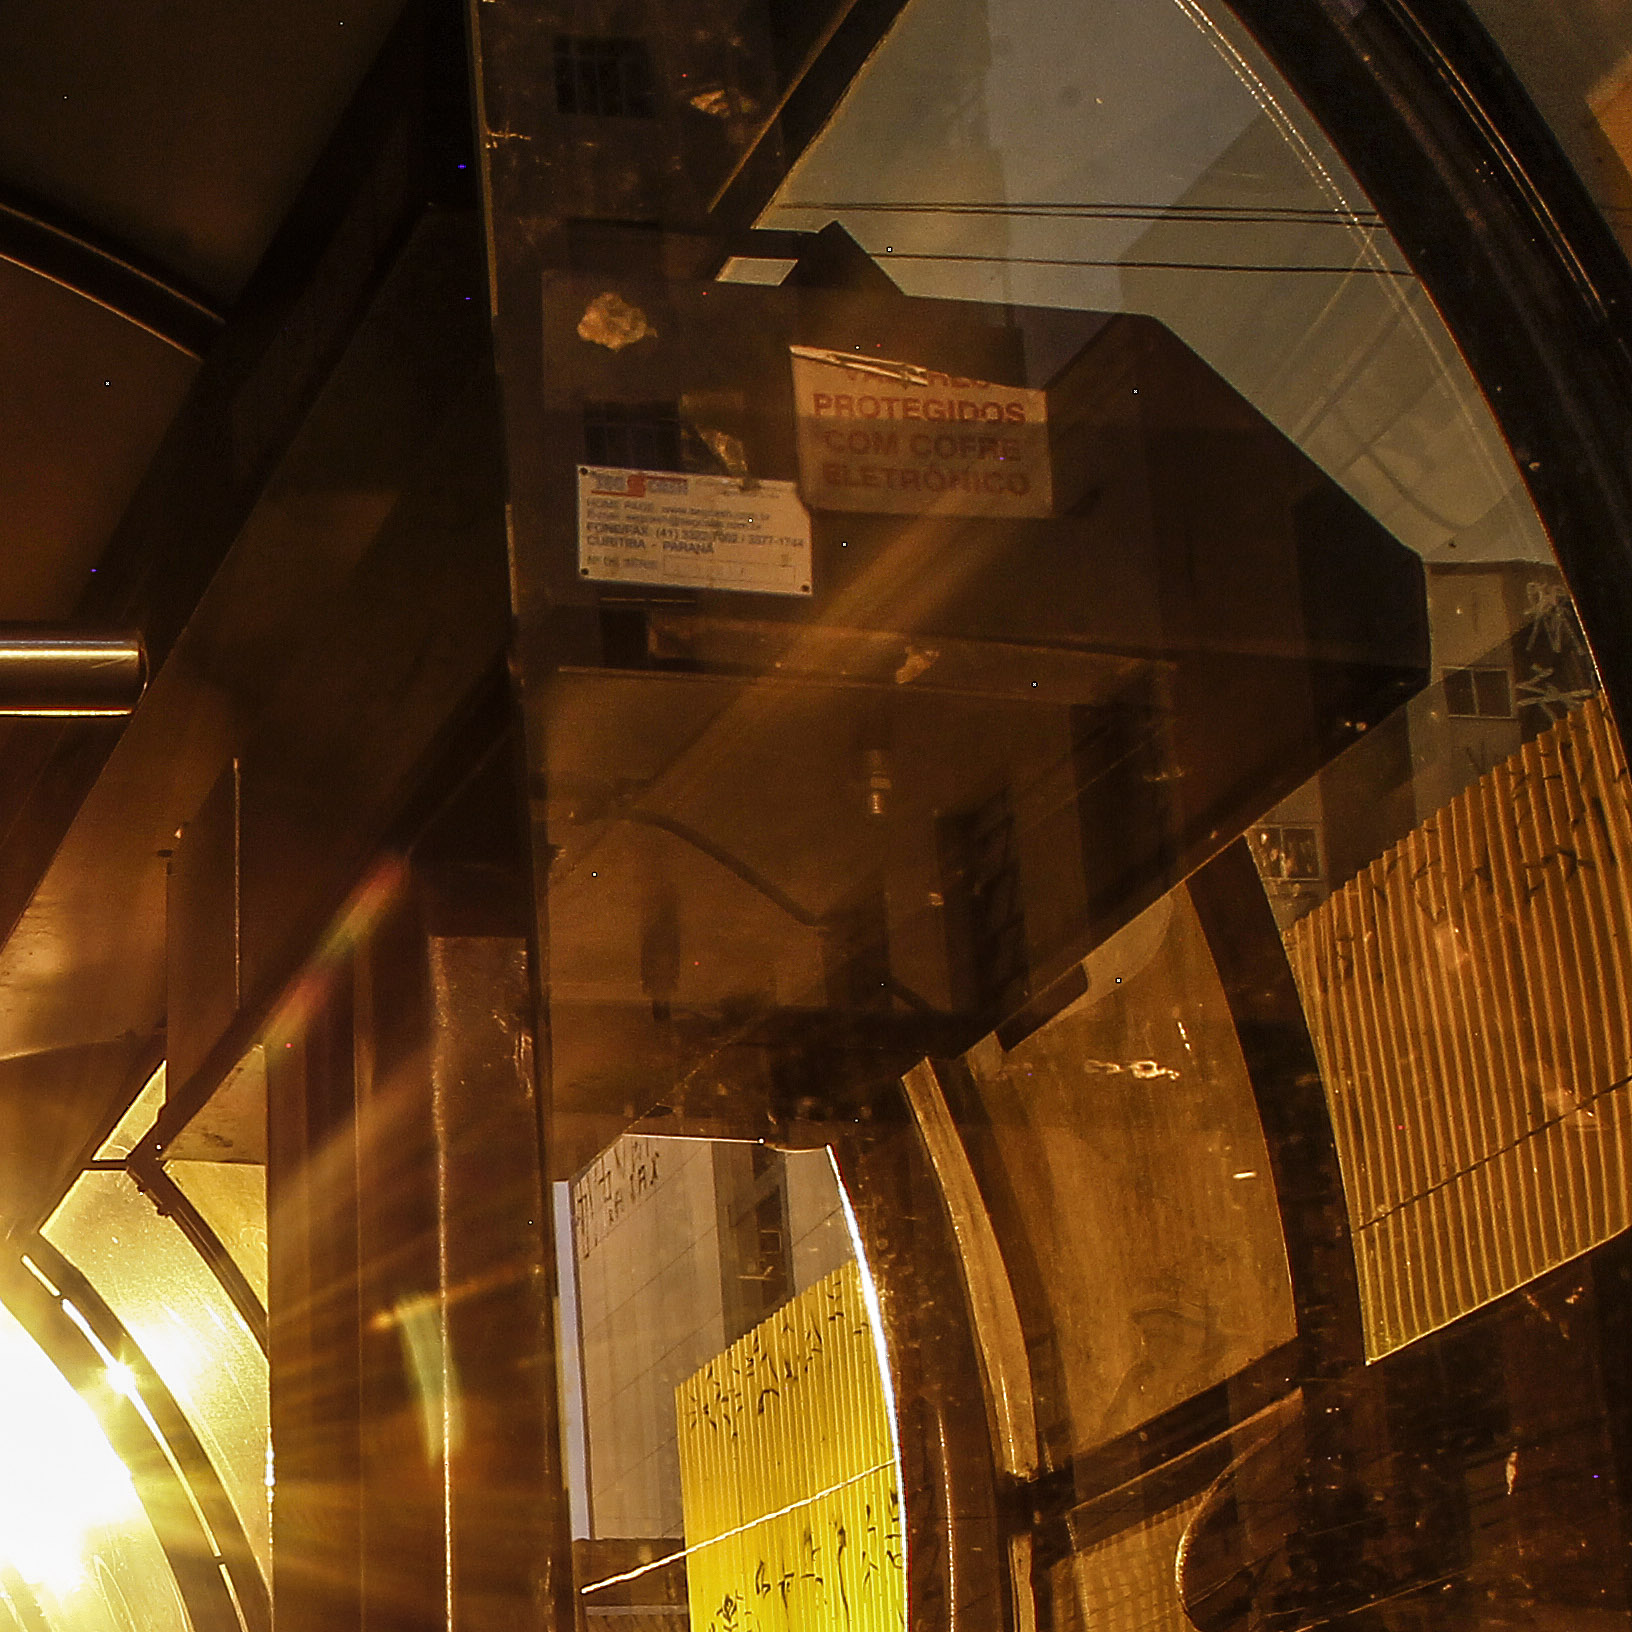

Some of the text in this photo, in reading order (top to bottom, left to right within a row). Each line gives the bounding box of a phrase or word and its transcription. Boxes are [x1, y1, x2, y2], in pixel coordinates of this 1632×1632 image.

[813, 394, 1026, 424] PROTEGIDOS
[823, 430, 1023, 462] COM COFRE
